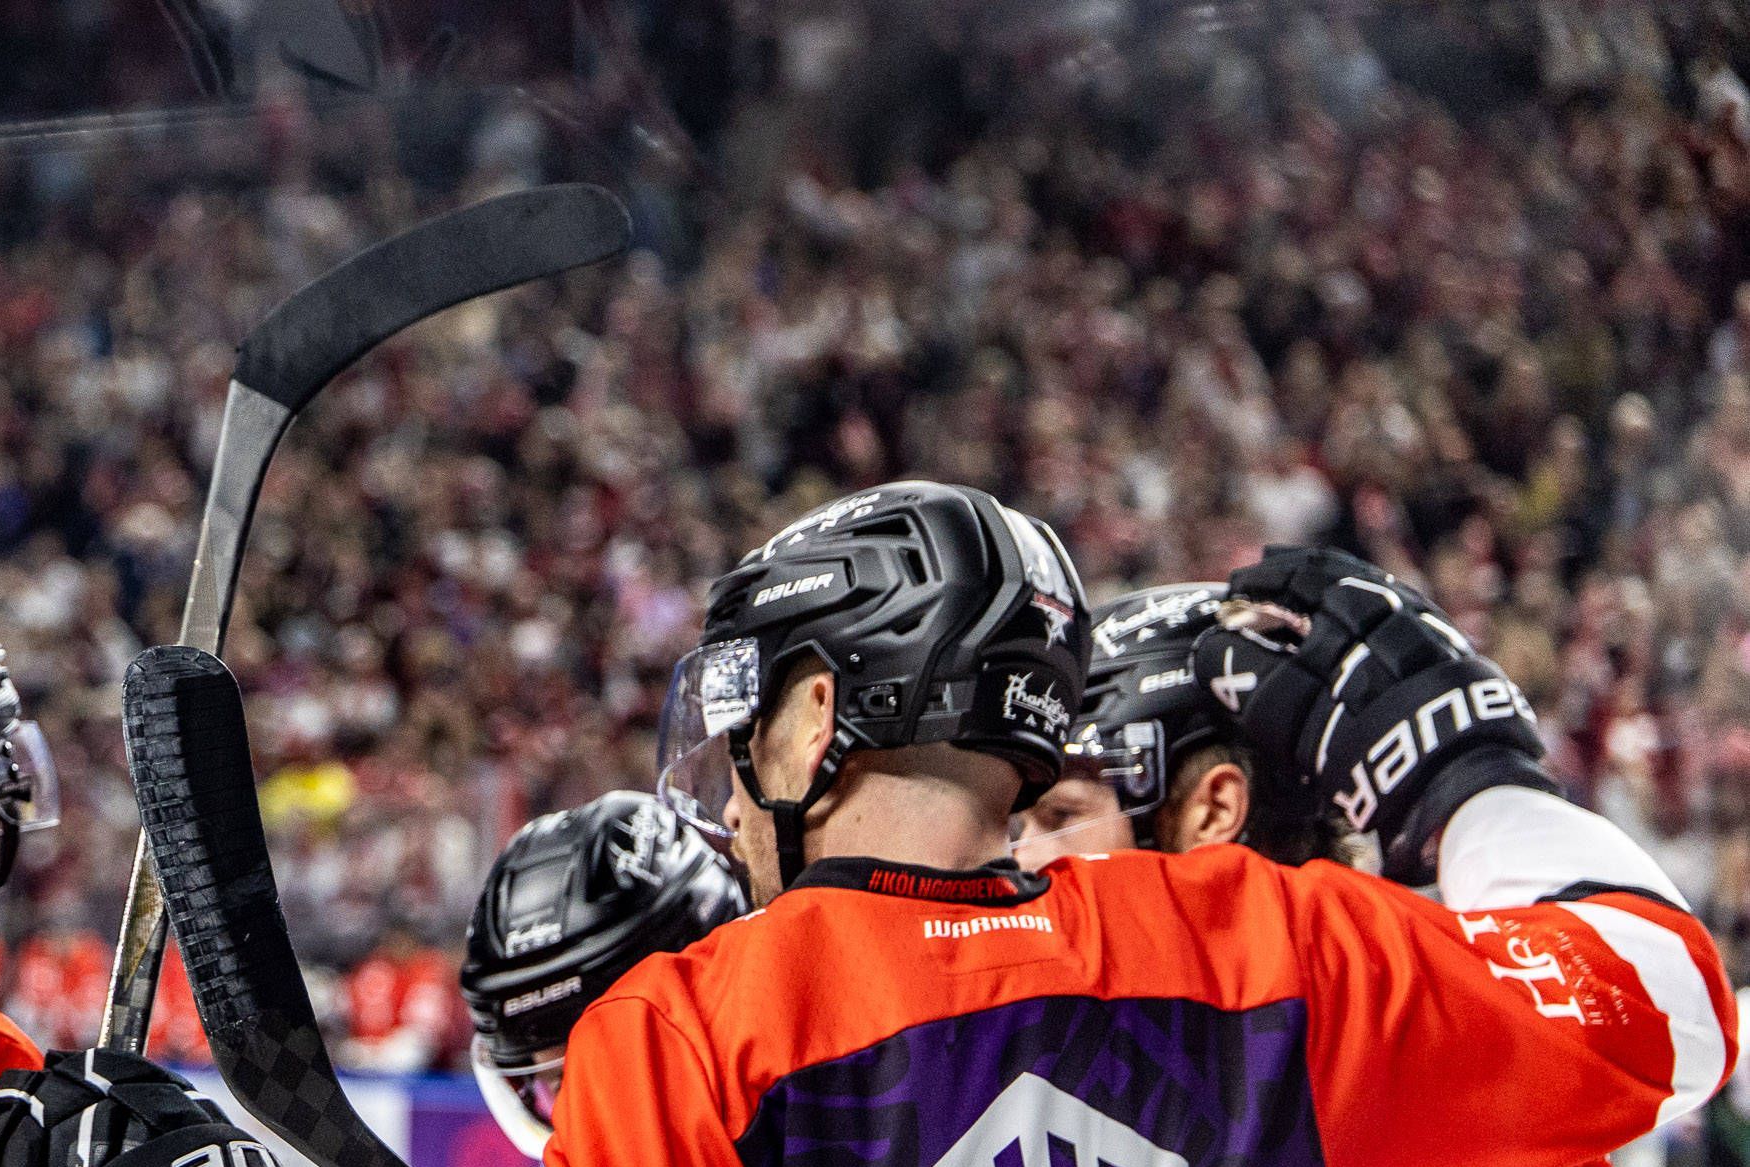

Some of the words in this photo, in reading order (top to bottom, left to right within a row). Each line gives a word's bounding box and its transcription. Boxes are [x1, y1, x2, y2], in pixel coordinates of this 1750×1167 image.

[753, 573, 835, 607] BAUER
[1139, 668, 1195, 694] BAU
[924, 915, 1053, 939] WARRIOR
